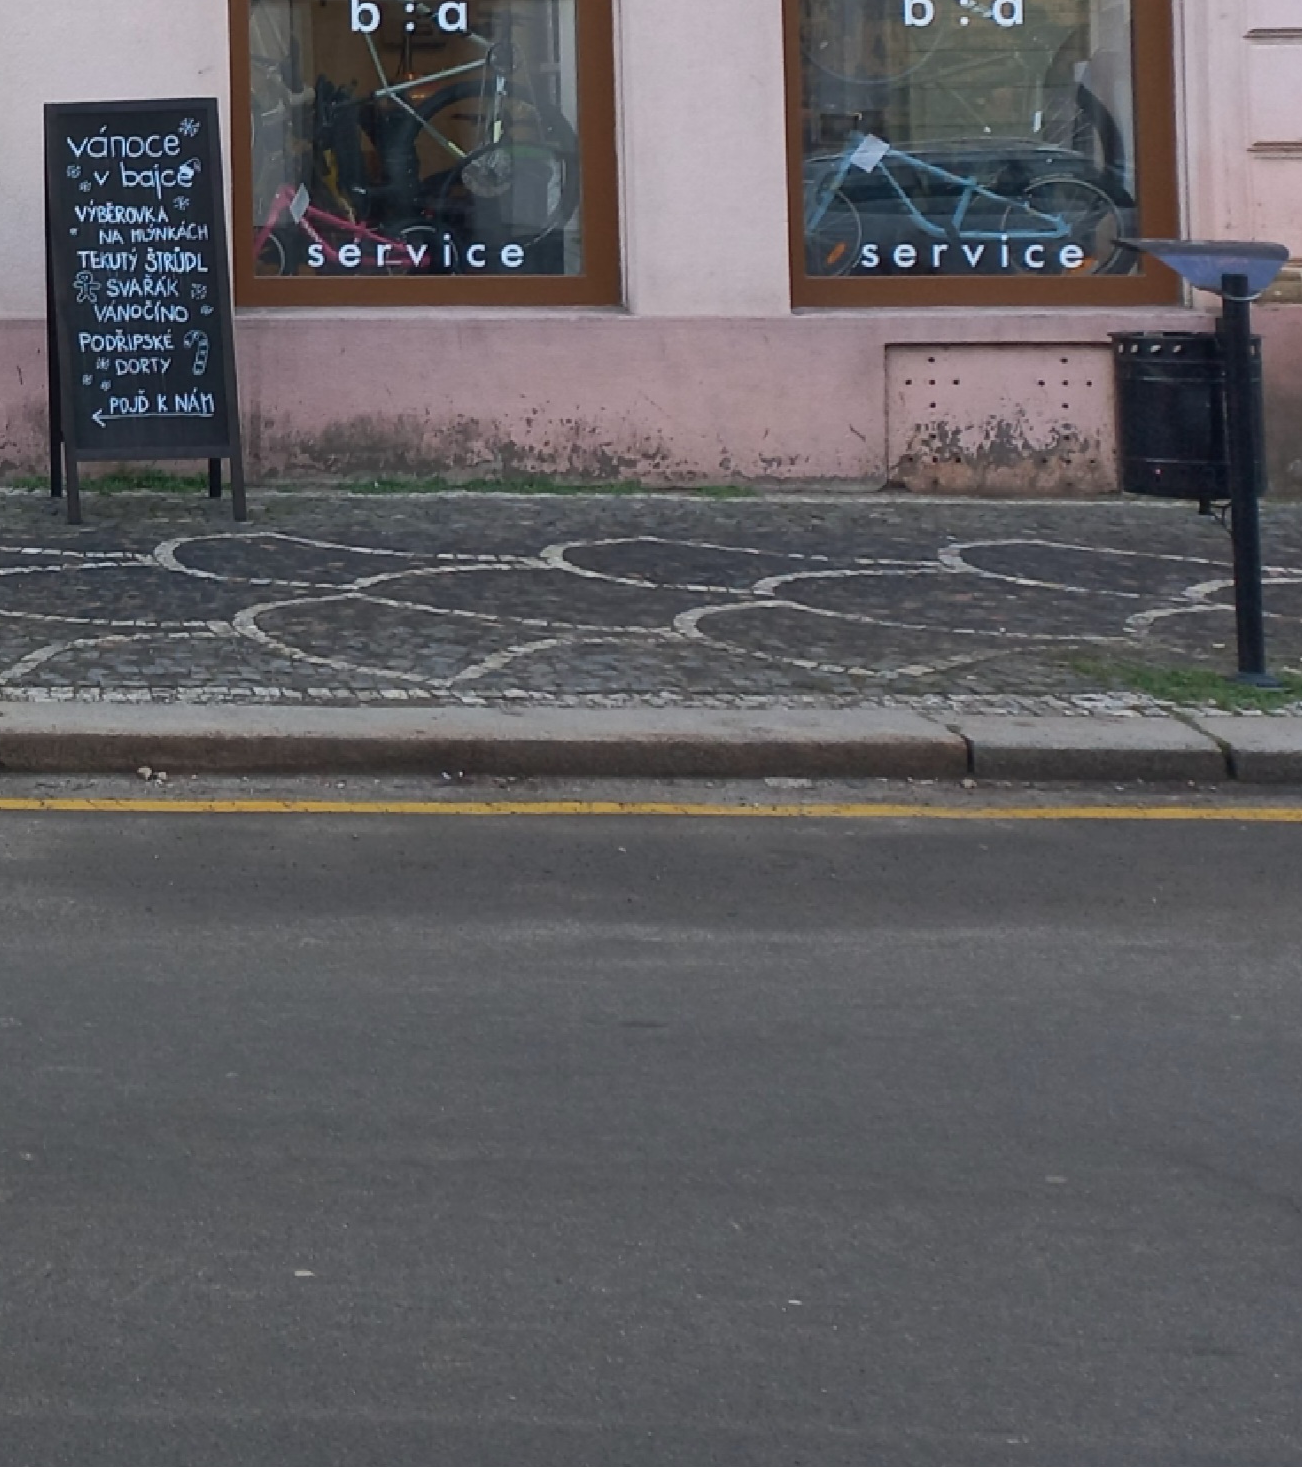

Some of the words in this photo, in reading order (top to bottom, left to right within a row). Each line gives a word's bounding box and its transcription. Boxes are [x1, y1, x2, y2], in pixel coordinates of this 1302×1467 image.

[66, 124, 181, 158] vánoce
[92, 169, 110, 187] v
[119, 160, 195, 201] bajce
[73, 198, 170, 225] VÝBĚROVKA
[98, 228, 125, 246] NA
[76, 246, 139, 272] TEKUTÝ
[306, 234, 526, 269] service
[861, 232, 1087, 270] service
[105, 273, 180, 298] SVAŘÁK
[114, 357, 173, 376] DORTY
[108, 388, 150, 414] POJĎ
[156, 393, 169, 414] K
[174, 386, 216, 414] NÁM
